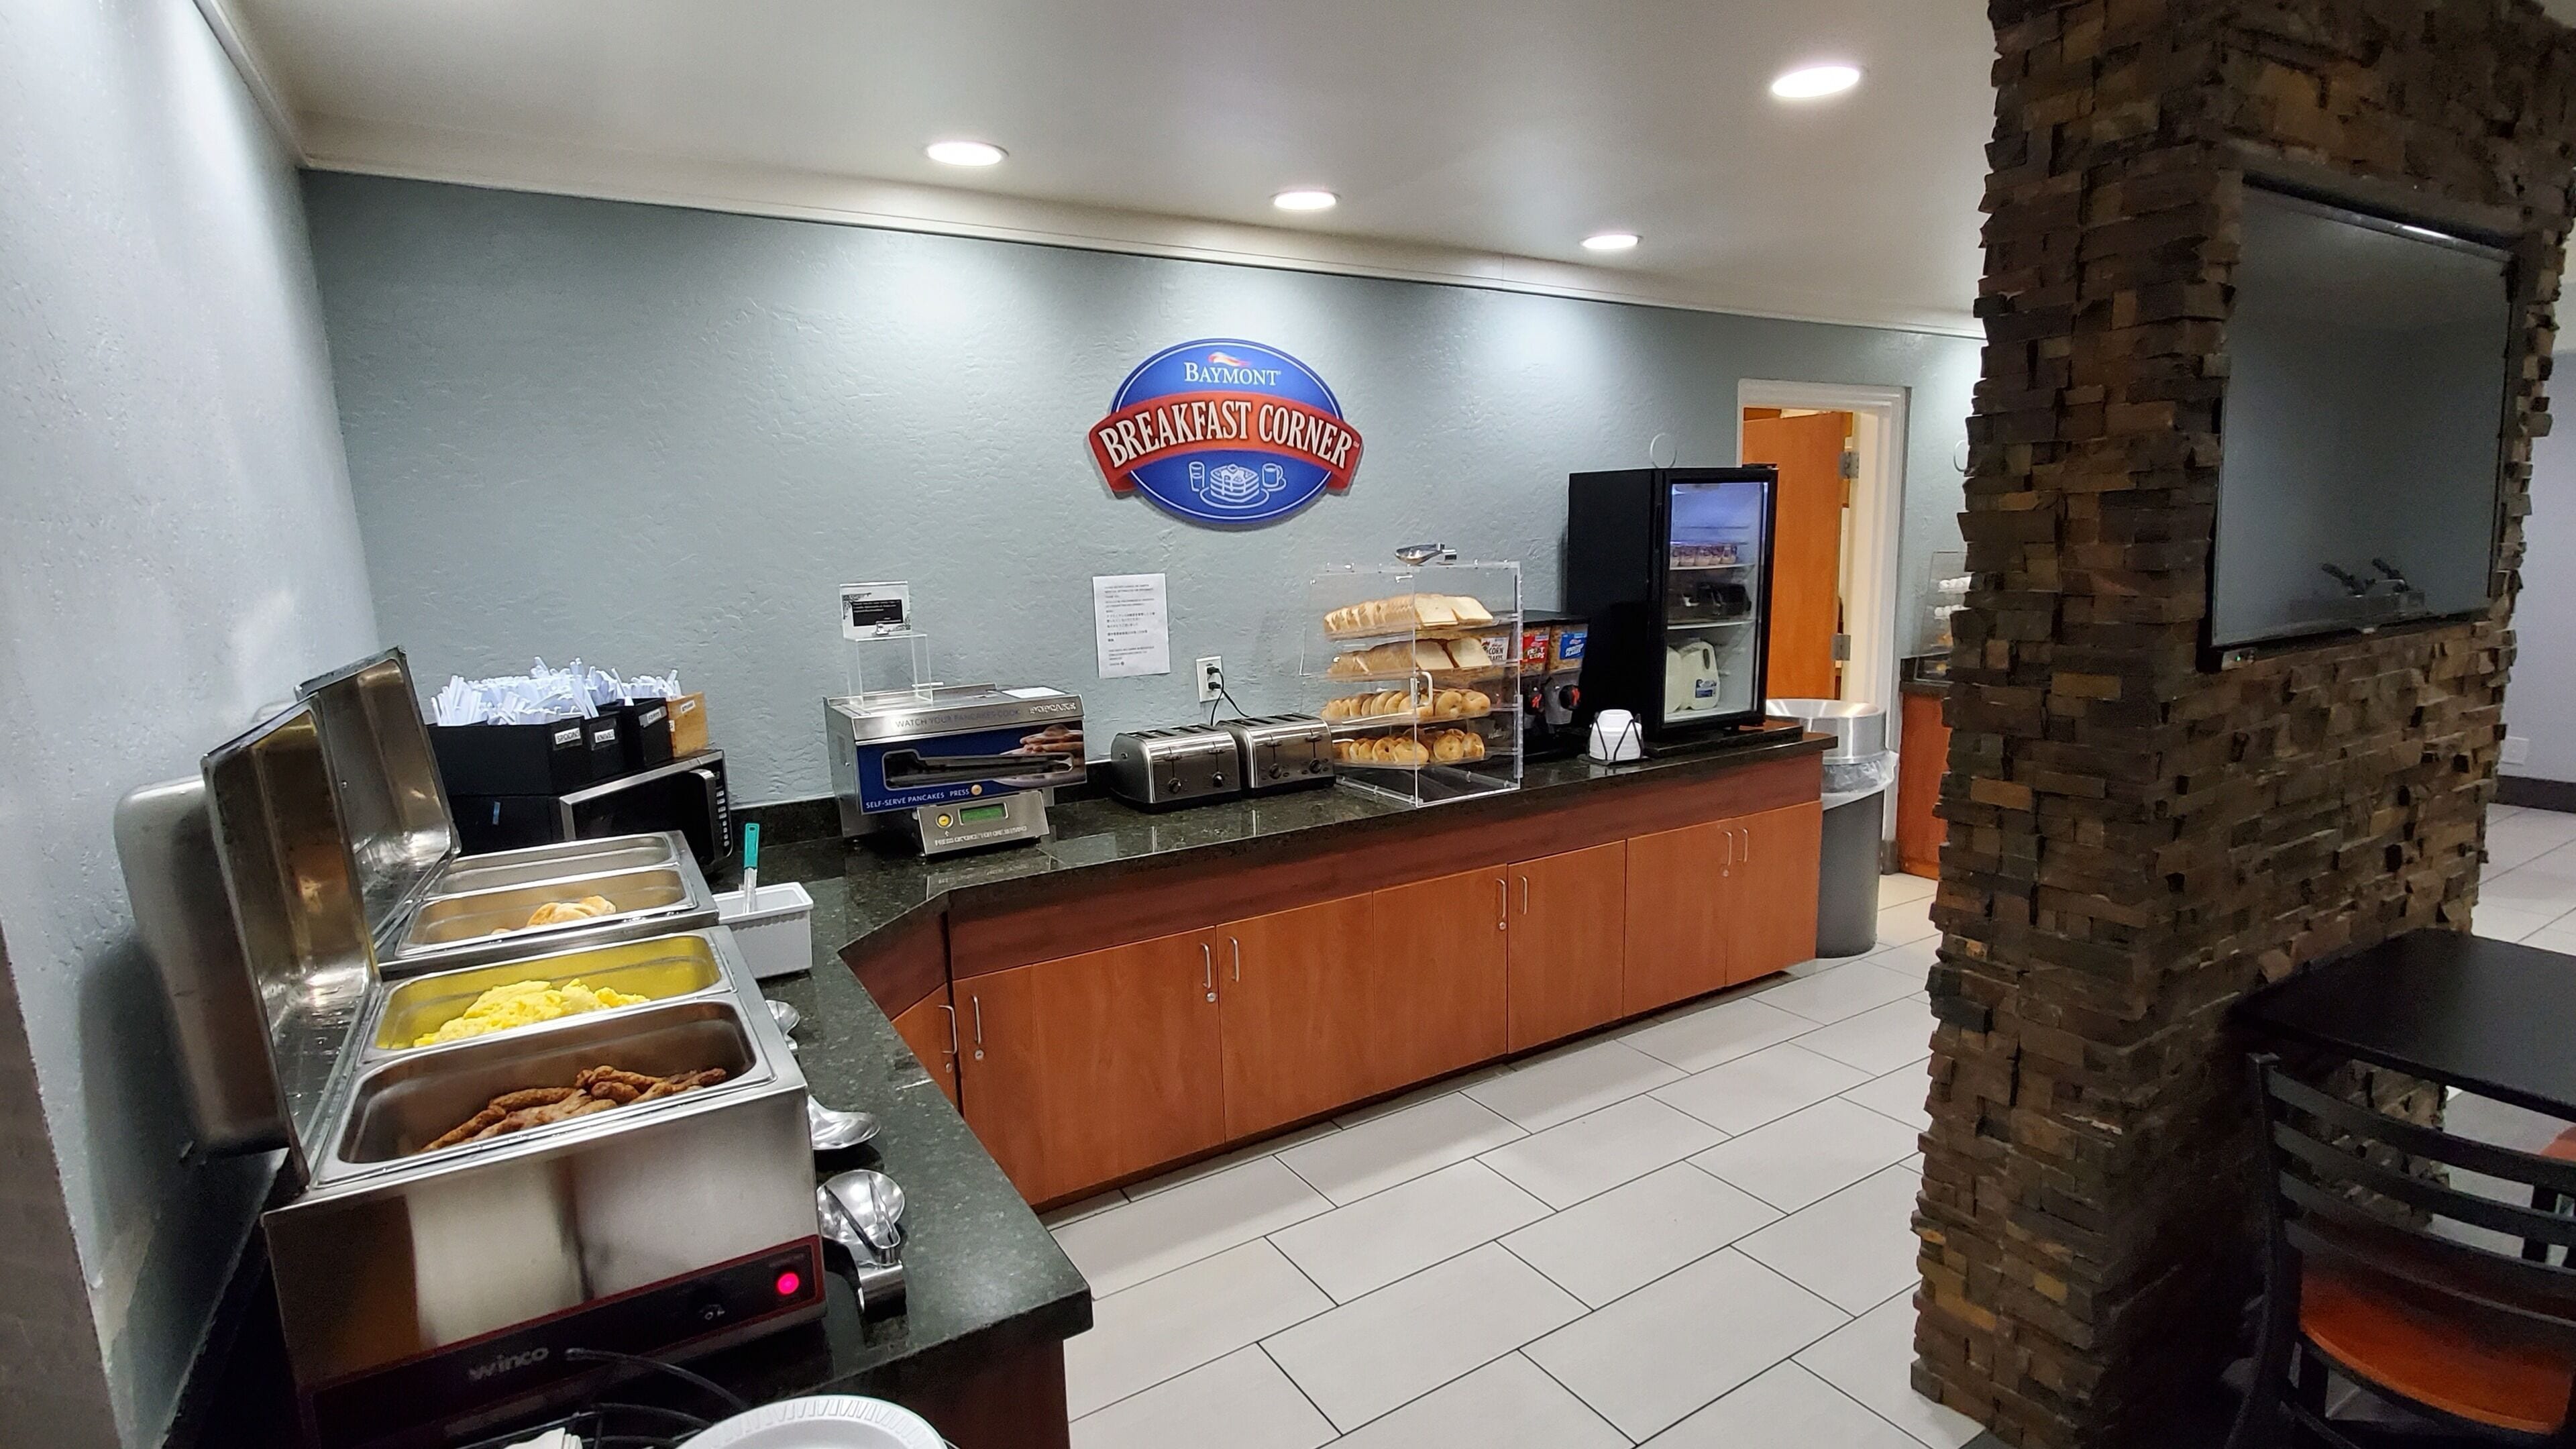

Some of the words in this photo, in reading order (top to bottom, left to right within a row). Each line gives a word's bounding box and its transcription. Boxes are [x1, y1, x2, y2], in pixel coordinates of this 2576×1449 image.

[1183, 362, 1278, 386] BAYMONT
[1099, 401, 1252, 468] BREAKFAST
[1258, 404, 1352, 468] CORNER
[1489, 647, 1503, 655] CORN
[896, 716, 927, 728] WATCH
[928, 715, 951, 724] YOUR
[954, 712, 994, 722] PANCAKES
[557, 729, 580, 743] SPOONS
[866, 797, 906, 808] SELF-SERVE
[908, 792, 945, 803] PANCAKES
[950, 788, 969, 796] PRESS
[469, 1347, 549, 1380] winco
